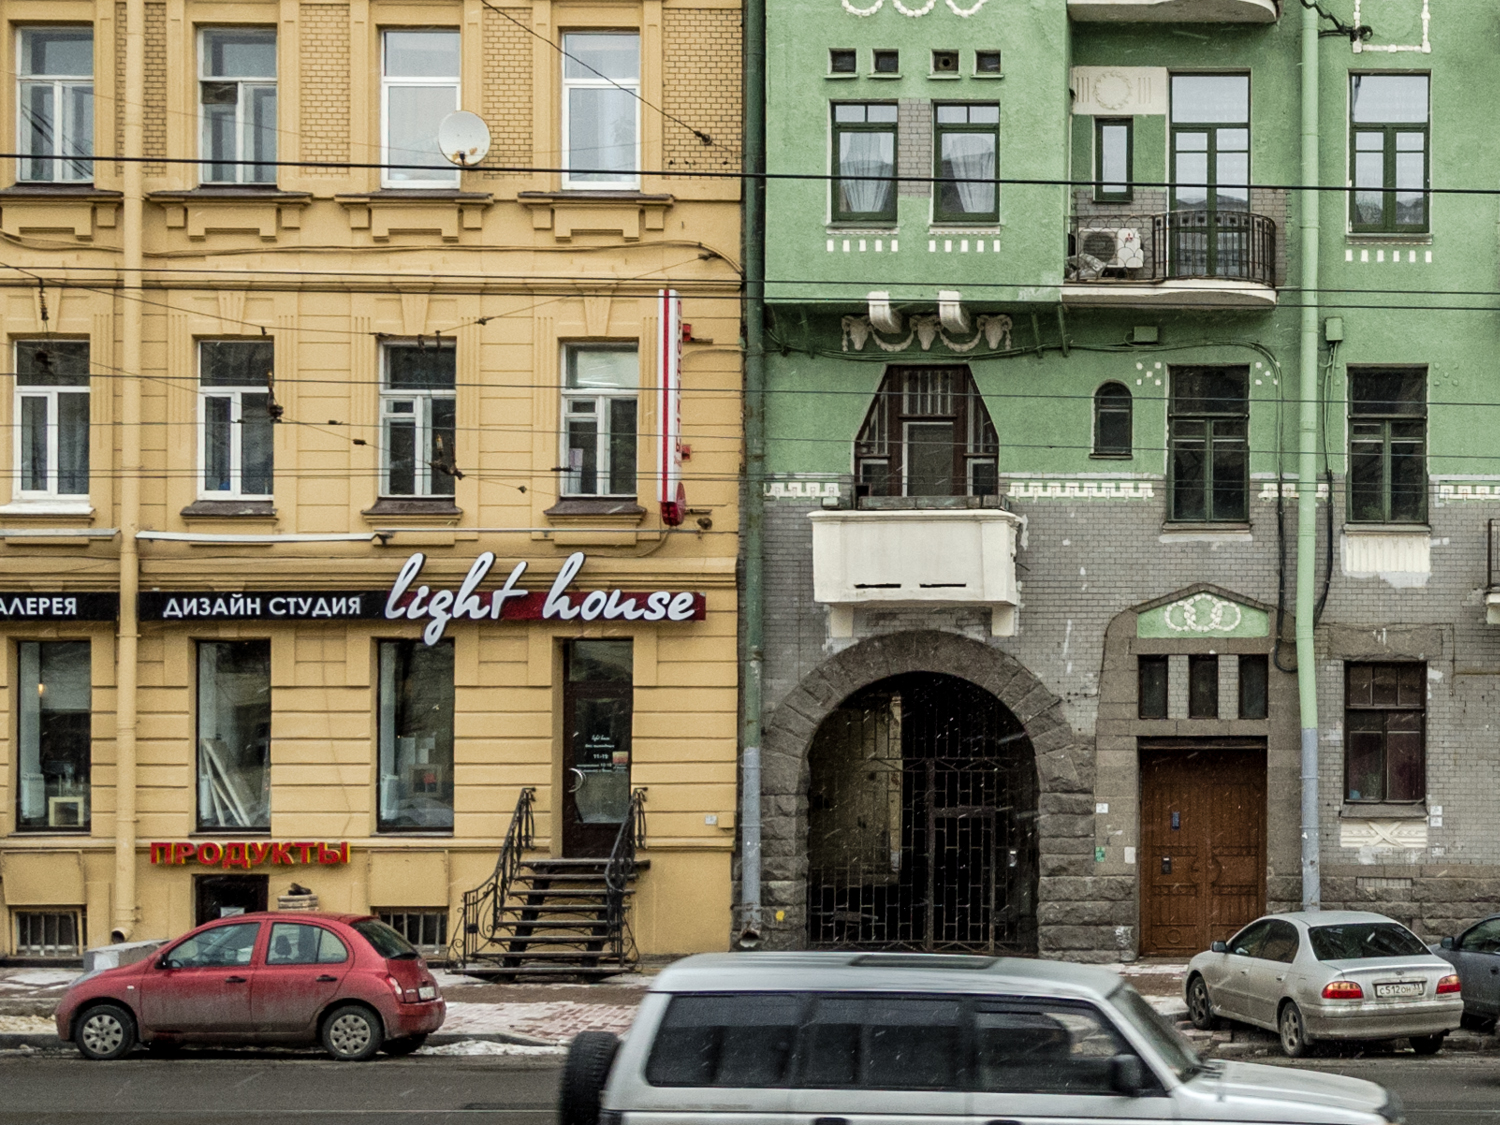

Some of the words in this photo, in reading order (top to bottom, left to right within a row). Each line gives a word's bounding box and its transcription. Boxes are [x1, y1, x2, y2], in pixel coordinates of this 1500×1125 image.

[163, 593, 261, 618] ДИЗАЙН
[269, 597, 361, 618] СТУДИЯ
[385, 552, 528, 646] light
[542, 552, 696, 621] house
[150, 842, 350, 868] ПРОДУКТЫ
